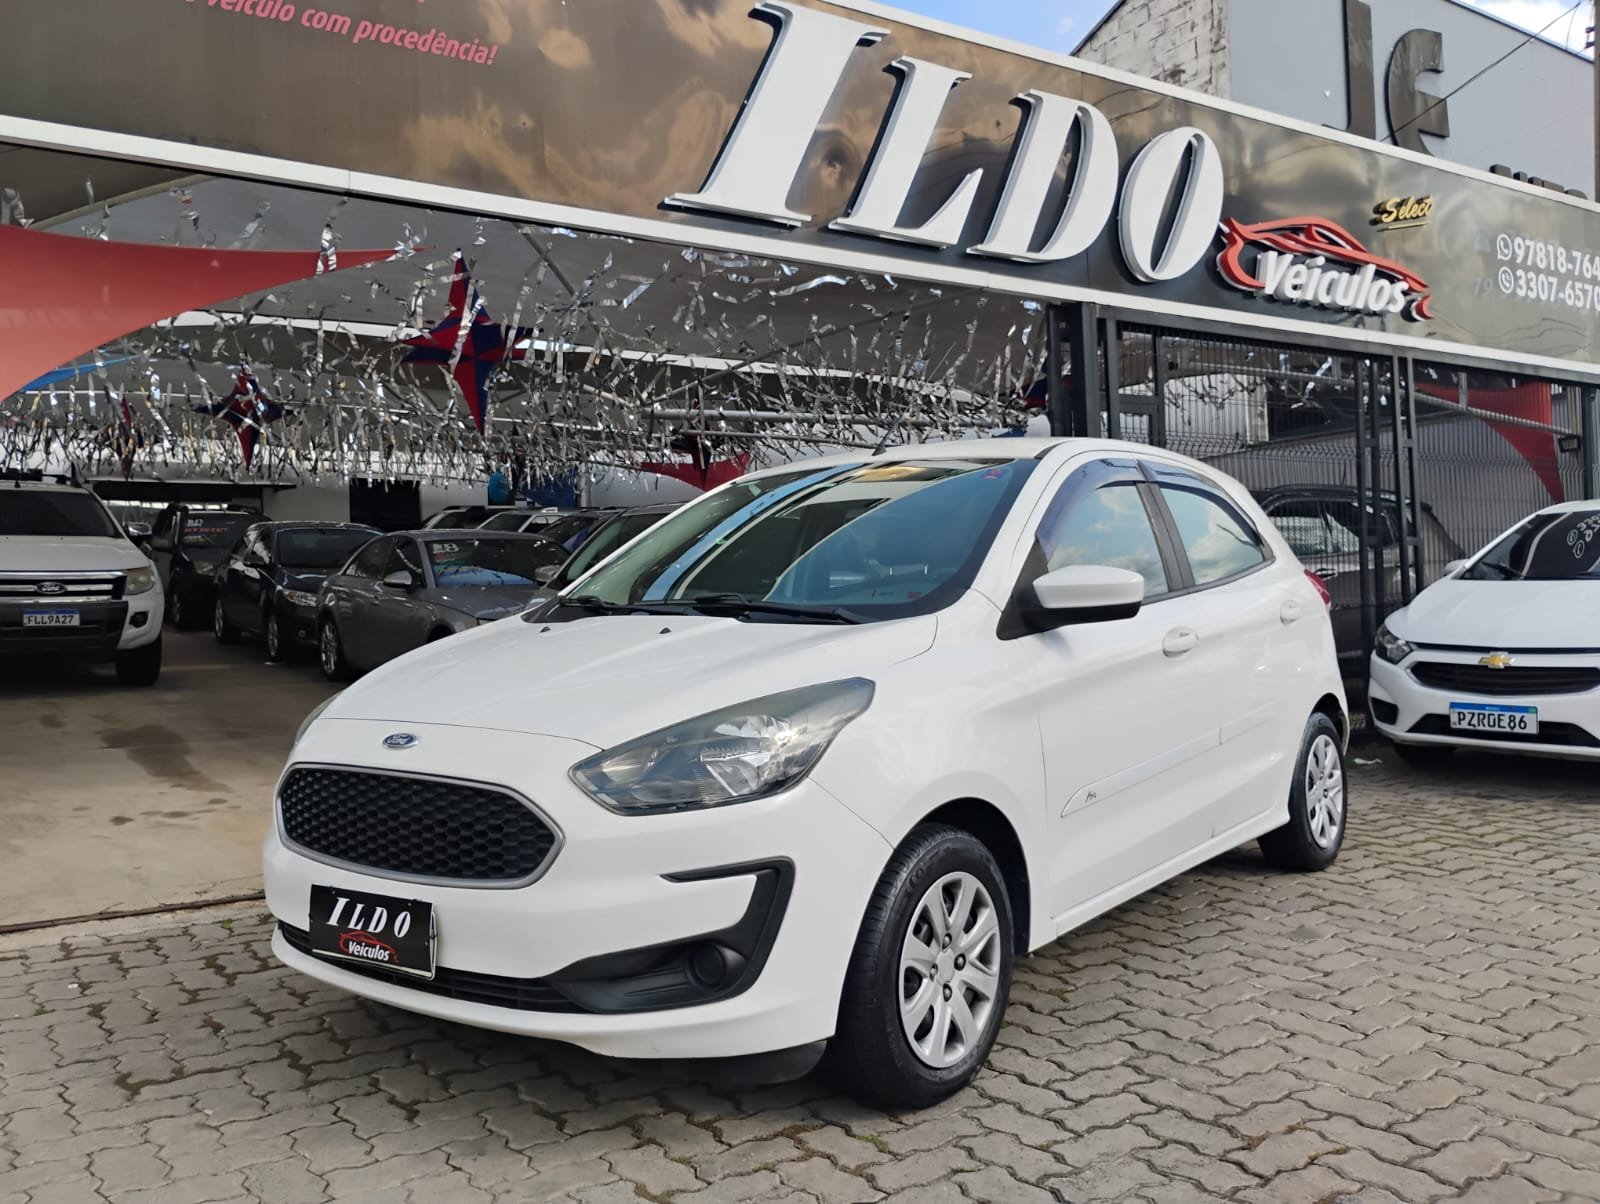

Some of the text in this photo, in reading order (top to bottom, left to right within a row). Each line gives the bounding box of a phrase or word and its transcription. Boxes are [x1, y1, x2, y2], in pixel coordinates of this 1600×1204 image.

[300, 8, 352, 35] com
[352, 20, 499, 66] procedência!
[660, 1, 1224, 284] ILDO
[1380, 195, 1436, 224] Select
[1257, 250, 1410, 314] Veículos
[26, 614, 74, 626] FLL9A27
[325, 897, 411, 938] ILDO
